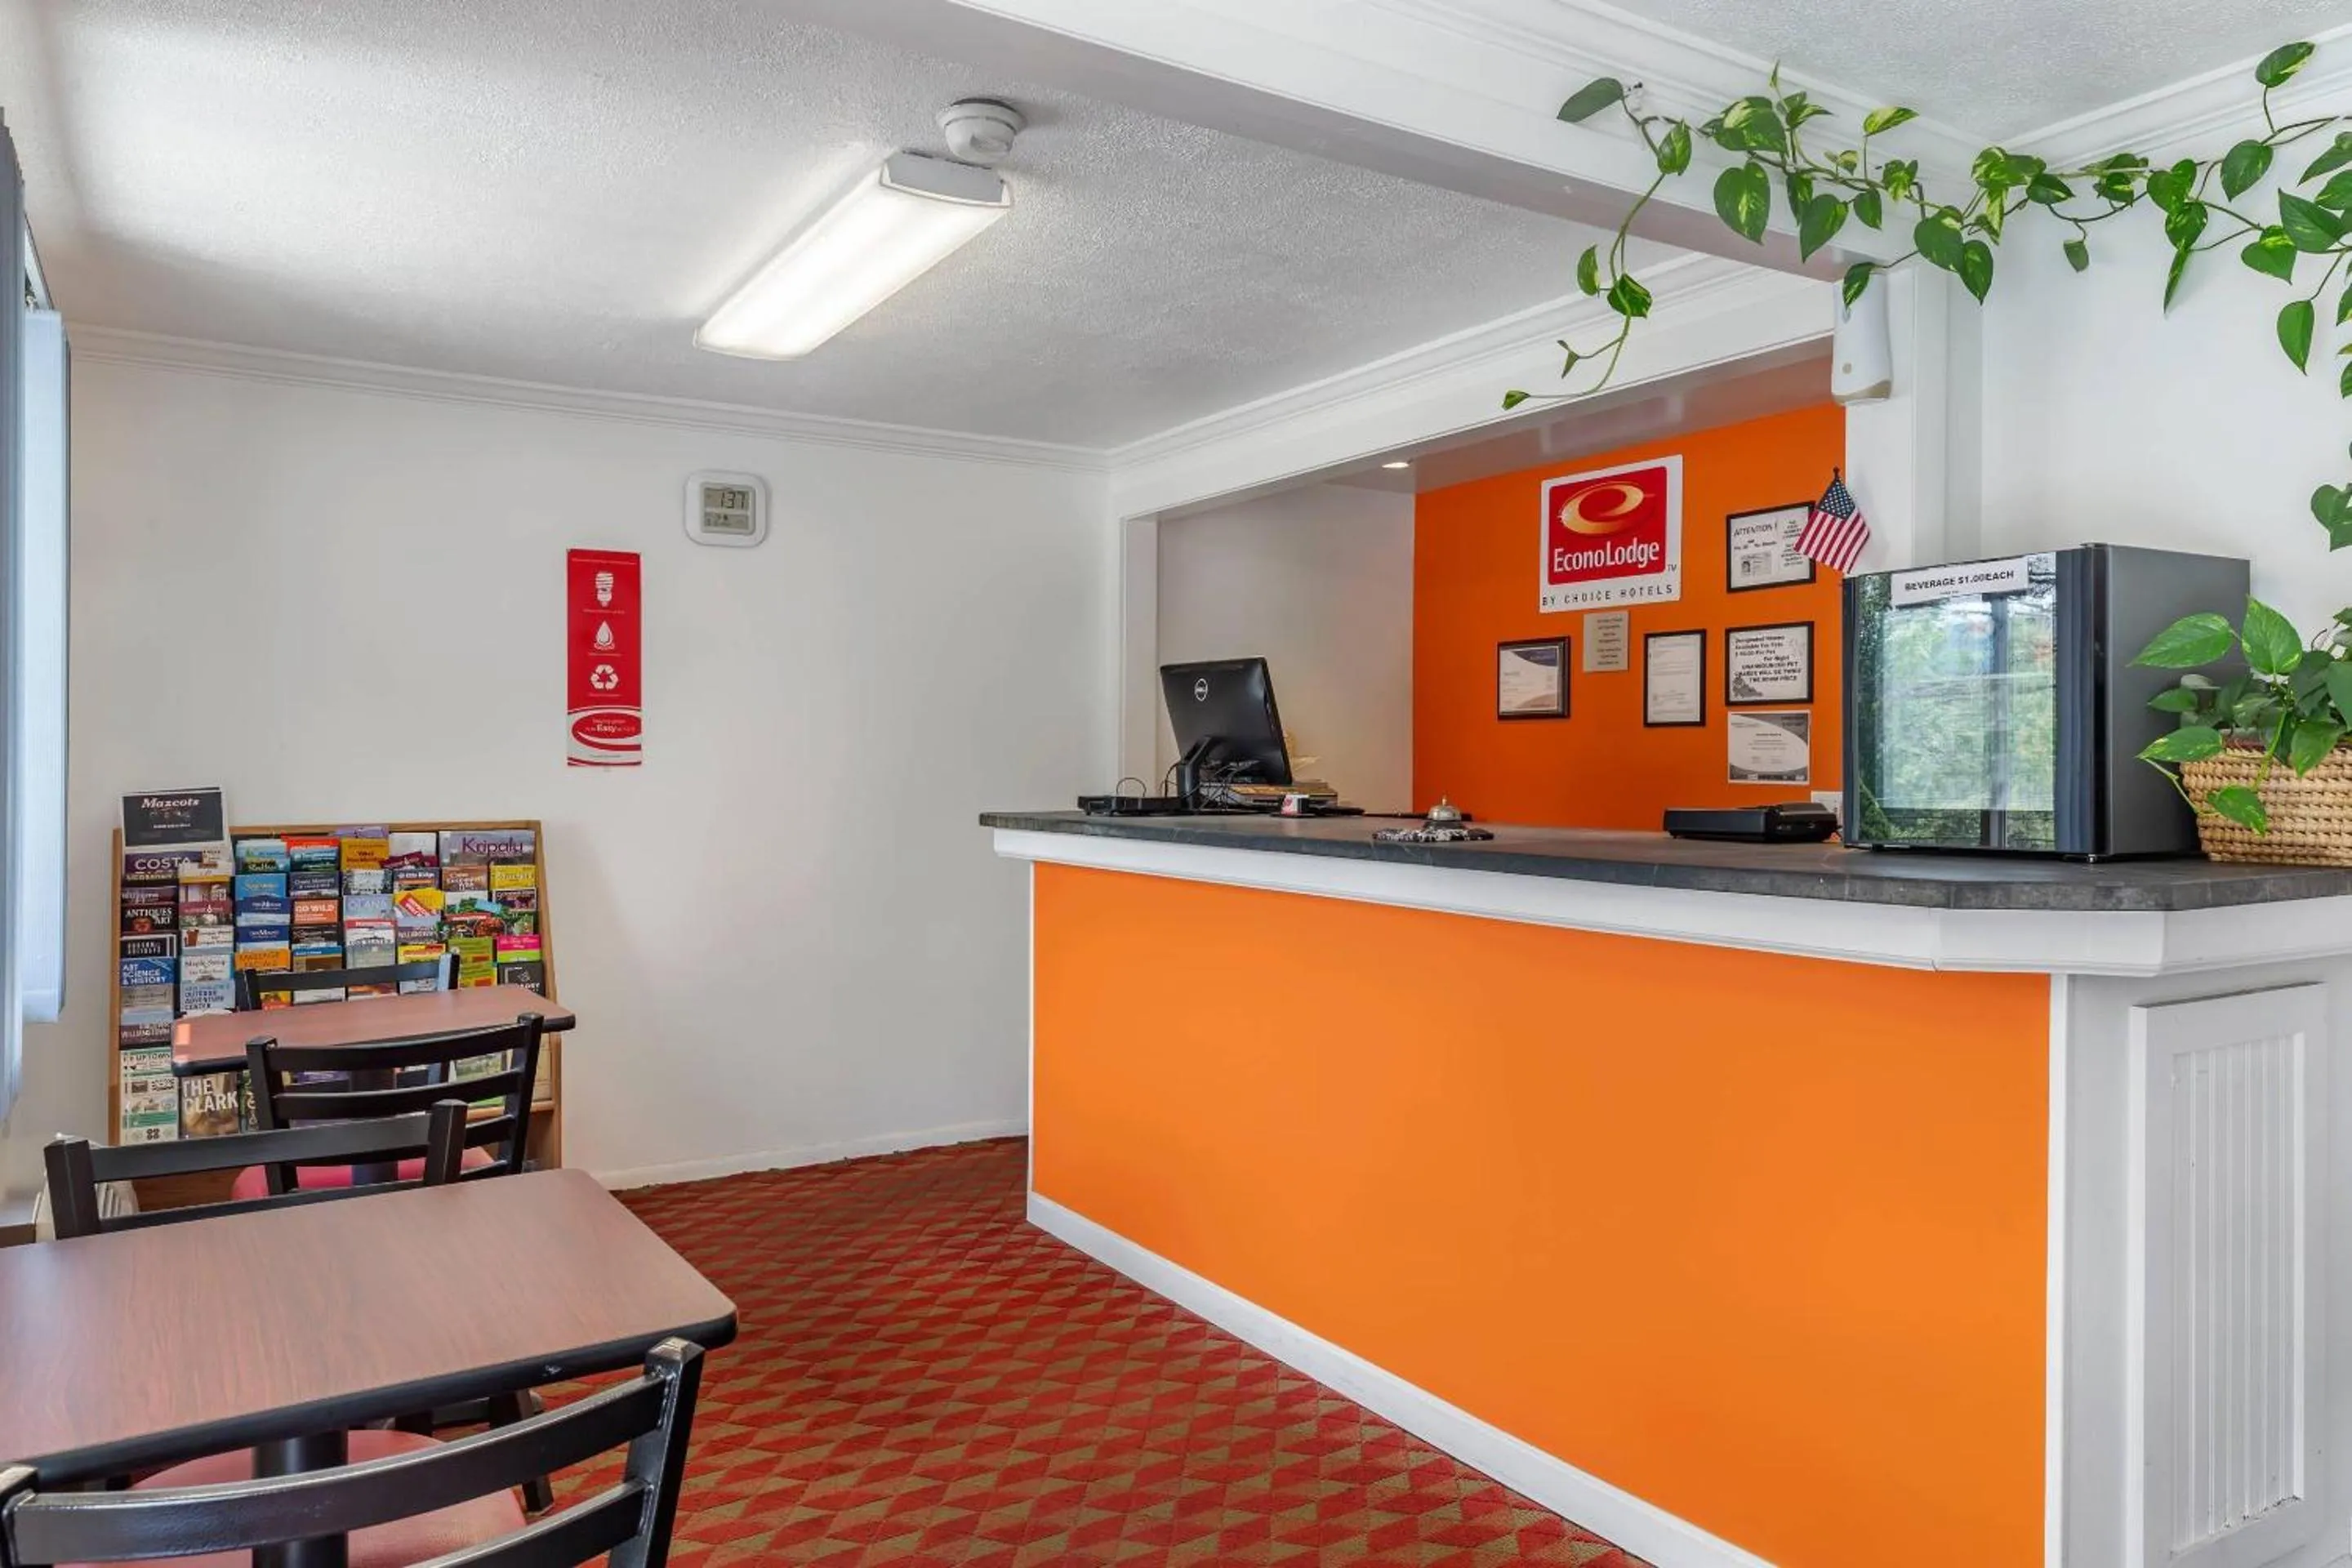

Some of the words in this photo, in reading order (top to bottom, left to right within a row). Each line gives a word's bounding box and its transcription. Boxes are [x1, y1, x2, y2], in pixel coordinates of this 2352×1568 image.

[1734, 523, 1772, 536] ATTENTION
[1554, 537, 1659, 572] EconoLodge
[1904, 577, 1956, 590] BEVERAGE
[1542, 596, 1556, 606] BY
[1564, 590, 1611, 604] CHOICE
[1620, 584, 1673, 598] HOTELS
[461, 836, 524, 857] Kripalu
[135, 857, 190, 871] COSTA
[182, 1079, 214, 1098] THE
[185, 1091, 239, 1114] CLARK
